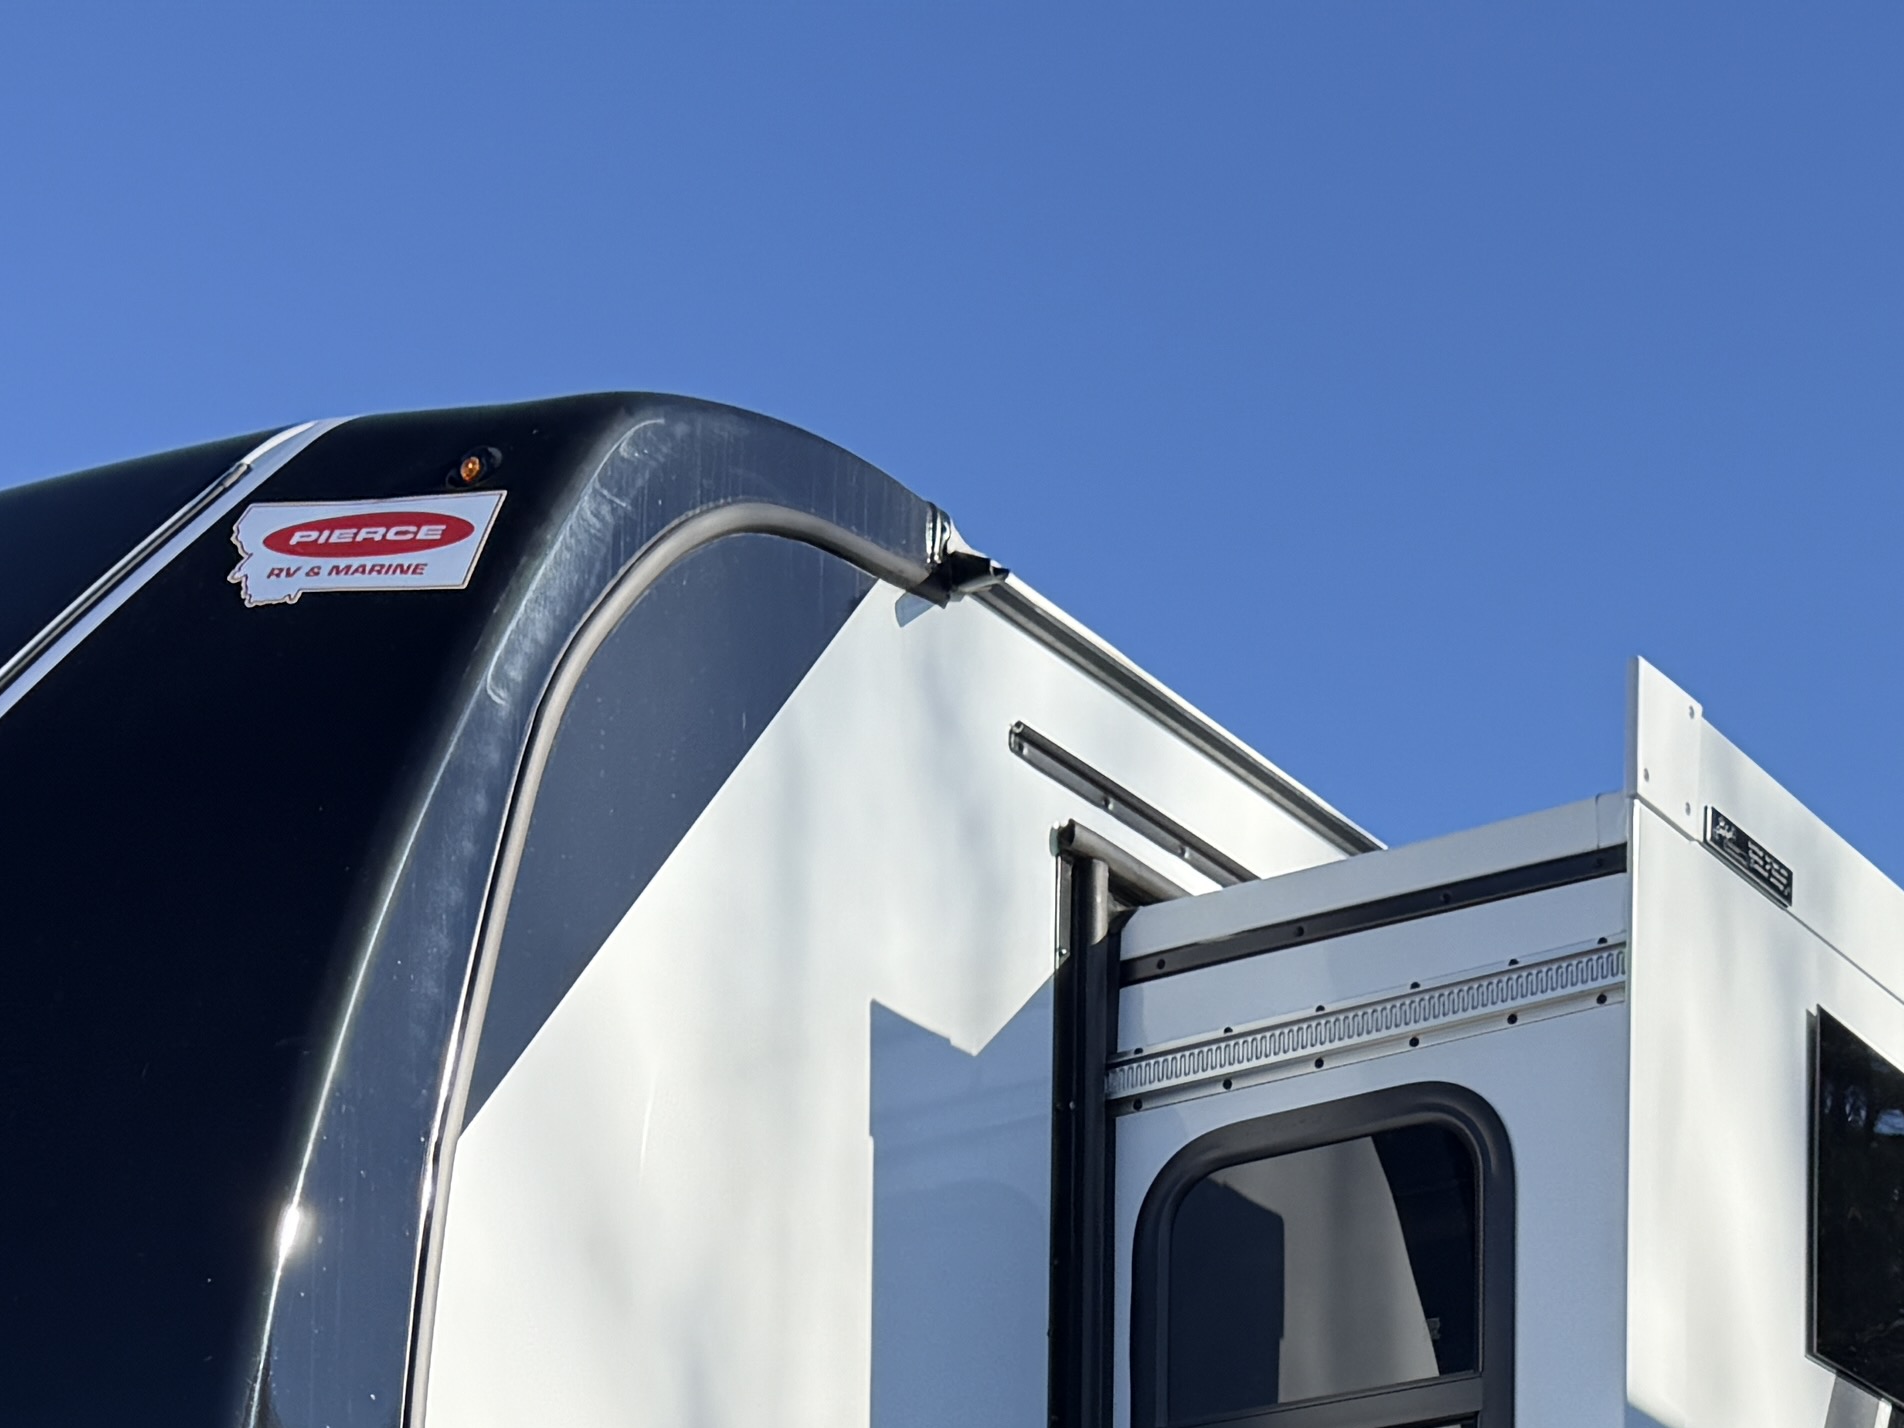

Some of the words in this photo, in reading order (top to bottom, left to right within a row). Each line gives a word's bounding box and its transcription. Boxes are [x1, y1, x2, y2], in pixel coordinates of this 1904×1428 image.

[289, 524, 447, 546] PIERCE
[266, 565, 303, 580] RV
[305, 566, 321, 578] &
[327, 562, 429, 577] MARINE
